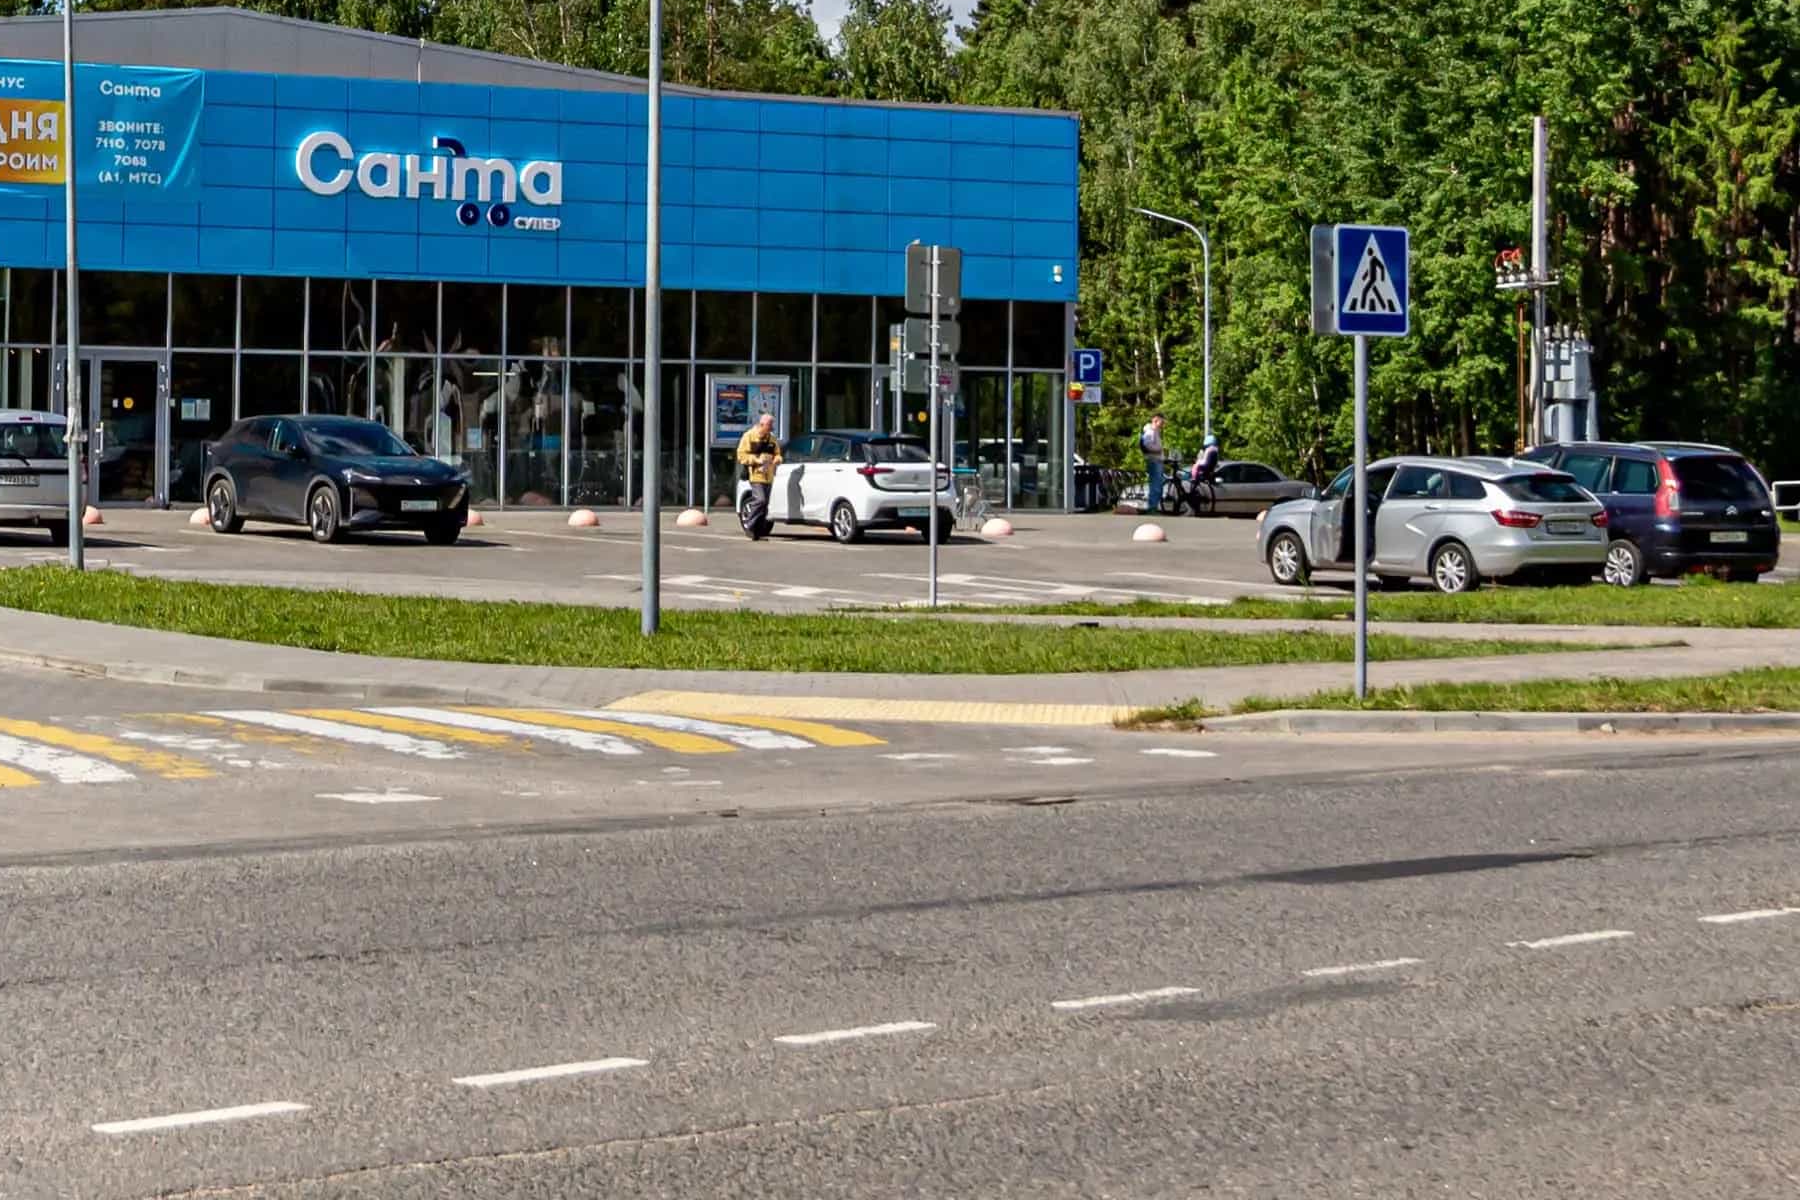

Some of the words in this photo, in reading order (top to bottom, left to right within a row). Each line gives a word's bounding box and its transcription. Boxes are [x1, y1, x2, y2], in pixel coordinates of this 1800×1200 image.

[99, 79, 161, 97] Санта
[295, 131, 563, 205] Санта
[1079, 353, 1095, 380] P
